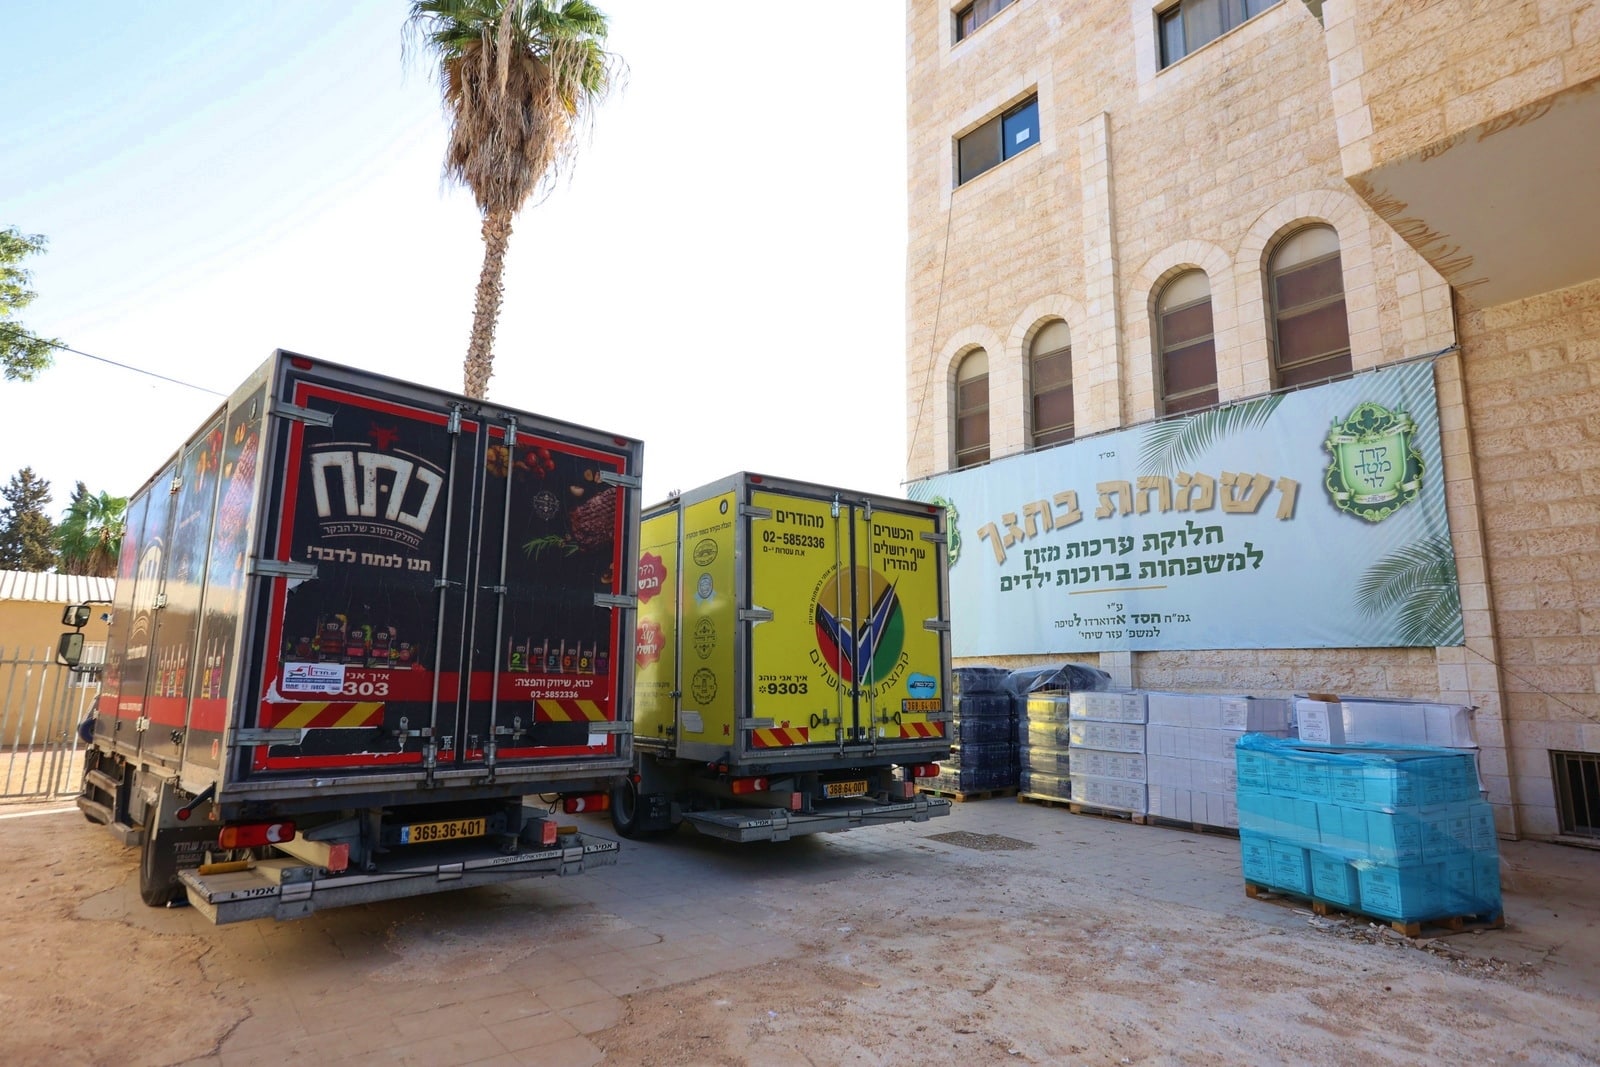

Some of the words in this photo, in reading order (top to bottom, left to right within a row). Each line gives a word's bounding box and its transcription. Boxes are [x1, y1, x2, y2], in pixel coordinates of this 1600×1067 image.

[1359, 446, 1387, 464] קרן
[1354, 460, 1392, 476] מטה
[1363, 473, 1385, 489] לוי
[1095, 471, 1298, 521] ושמחת
[776, 510, 824, 529] מהודרים
[323, 525, 351, 535] הבקר
[352, 523, 367, 533] של
[369, 527, 394, 537] הטוב
[873, 524, 913, 541] הכשרים
[977, 489, 1083, 566] בחגך
[395, 530, 420, 546] החלק
[763, 530, 825, 549] 02-5852336
[1142, 520, 1224, 555] חלוקת
[306, 545, 357, 563] לדבר!
[873, 540, 907, 556] ירושלים
[910, 547, 925, 561] עוף
[1066, 535, 1134, 560] ערכות
[361, 552, 402, 568] לנתח
[407, 557, 431, 572] תנו
[883, 557, 917, 572] מהדרין
[1023, 545, 1061, 571] מזון
[1138, 542, 1264, 579] למשפחות
[1000, 565, 1051, 592] ילדים
[1056, 562, 1131, 586] ברוכות
[638, 576, 658, 589] הבש
[1107, 602, 1123, 612] ע"י
[1054, 613, 1081, 628] לטיפה
[1084, 614, 1126, 627] אדוארדו
[1130, 612, 1161, 624] חסד
[1164, 613, 1191, 624] גמ"ח
[1106, 630, 1122, 639] עזר
[1126, 626, 1160, 638] למשפ'
[512, 653, 520, 664] 2
[548, 656, 555, 665] 5
[580, 657, 588, 667] 8
[345, 672, 365, 680] אני
[369, 672, 390, 681] איך
[795, 675, 808, 683] איך
[881, 651, 909, 694] קבוצת
[547, 679, 571, 689] שיווק
[530, 690, 579, 698] 02-5852336
[244, 886, 275, 897] אמיר
